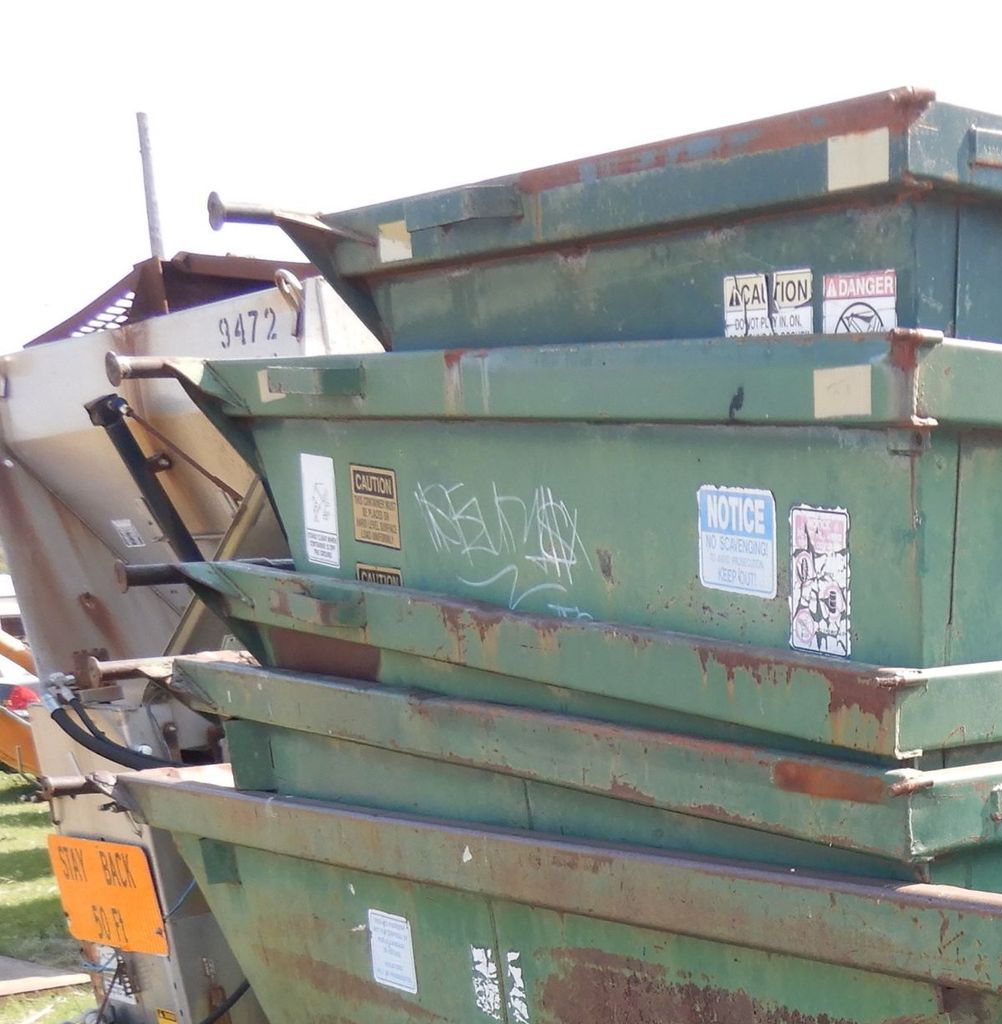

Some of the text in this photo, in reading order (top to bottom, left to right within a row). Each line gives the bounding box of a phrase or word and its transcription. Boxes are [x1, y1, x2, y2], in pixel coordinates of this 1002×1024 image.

[742, 279, 808, 306] CAUTION
[838, 277, 894, 296] DANGER
[218, 307, 278, 349] 9472
[760, 315, 778, 329] PLY
[355, 473, 392, 496] CAUTION
[706, 494, 766, 535] NOTICE
[705, 534, 716, 550] NO
[361, 571, 399, 586] CAUTION
[718, 566, 737, 583] KEEP
[58, 846, 137, 889] STAY BACK
[92, 904, 111, 941] 50
